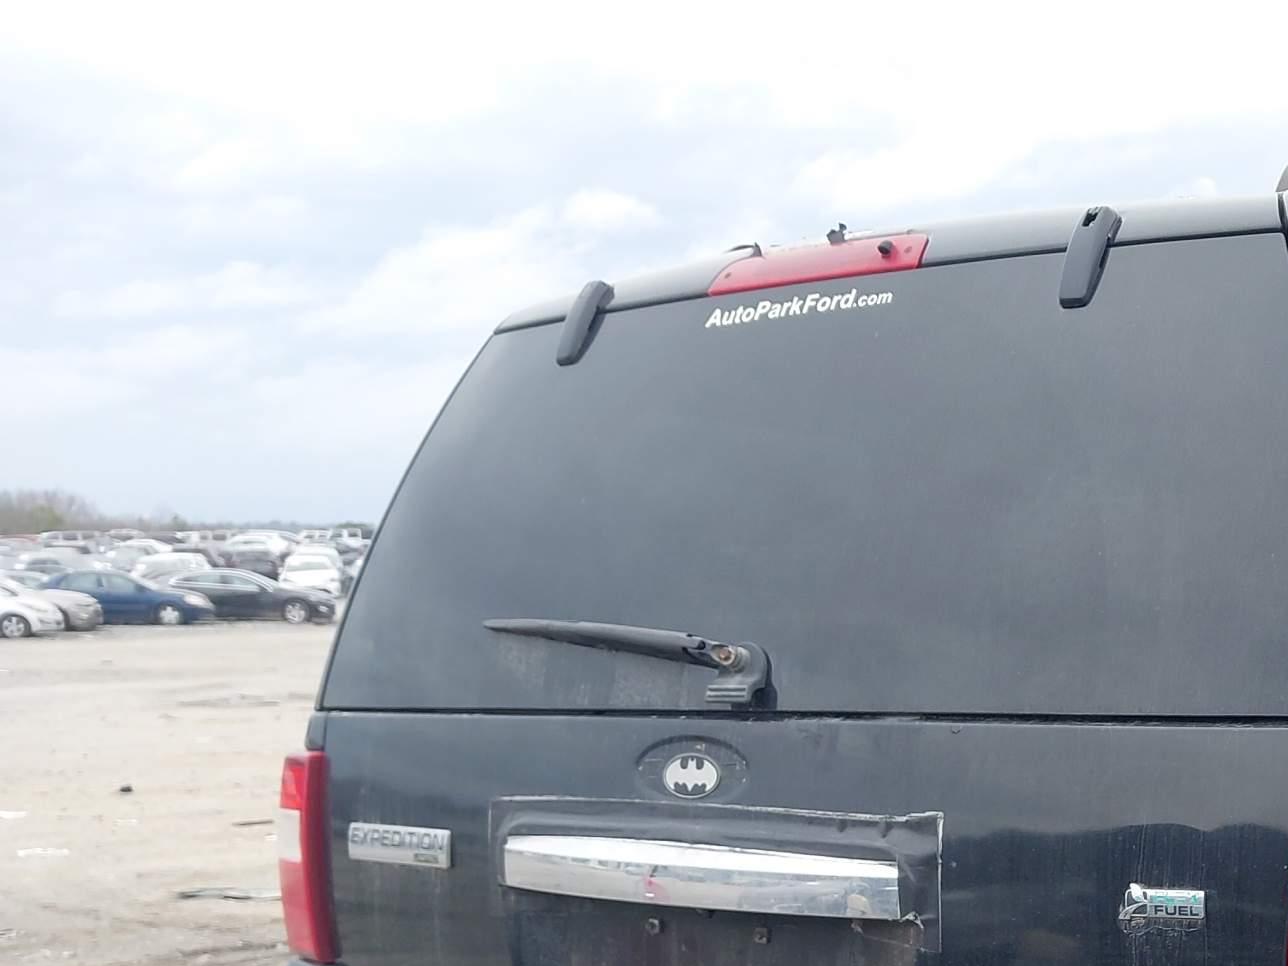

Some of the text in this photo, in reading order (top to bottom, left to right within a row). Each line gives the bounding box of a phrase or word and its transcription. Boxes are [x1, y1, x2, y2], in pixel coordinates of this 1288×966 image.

[704, 288, 893, 329] AutoParkFord.com
[349, 826, 446, 851] EXPEDITION
[1154, 904, 1200, 917] FUEL
